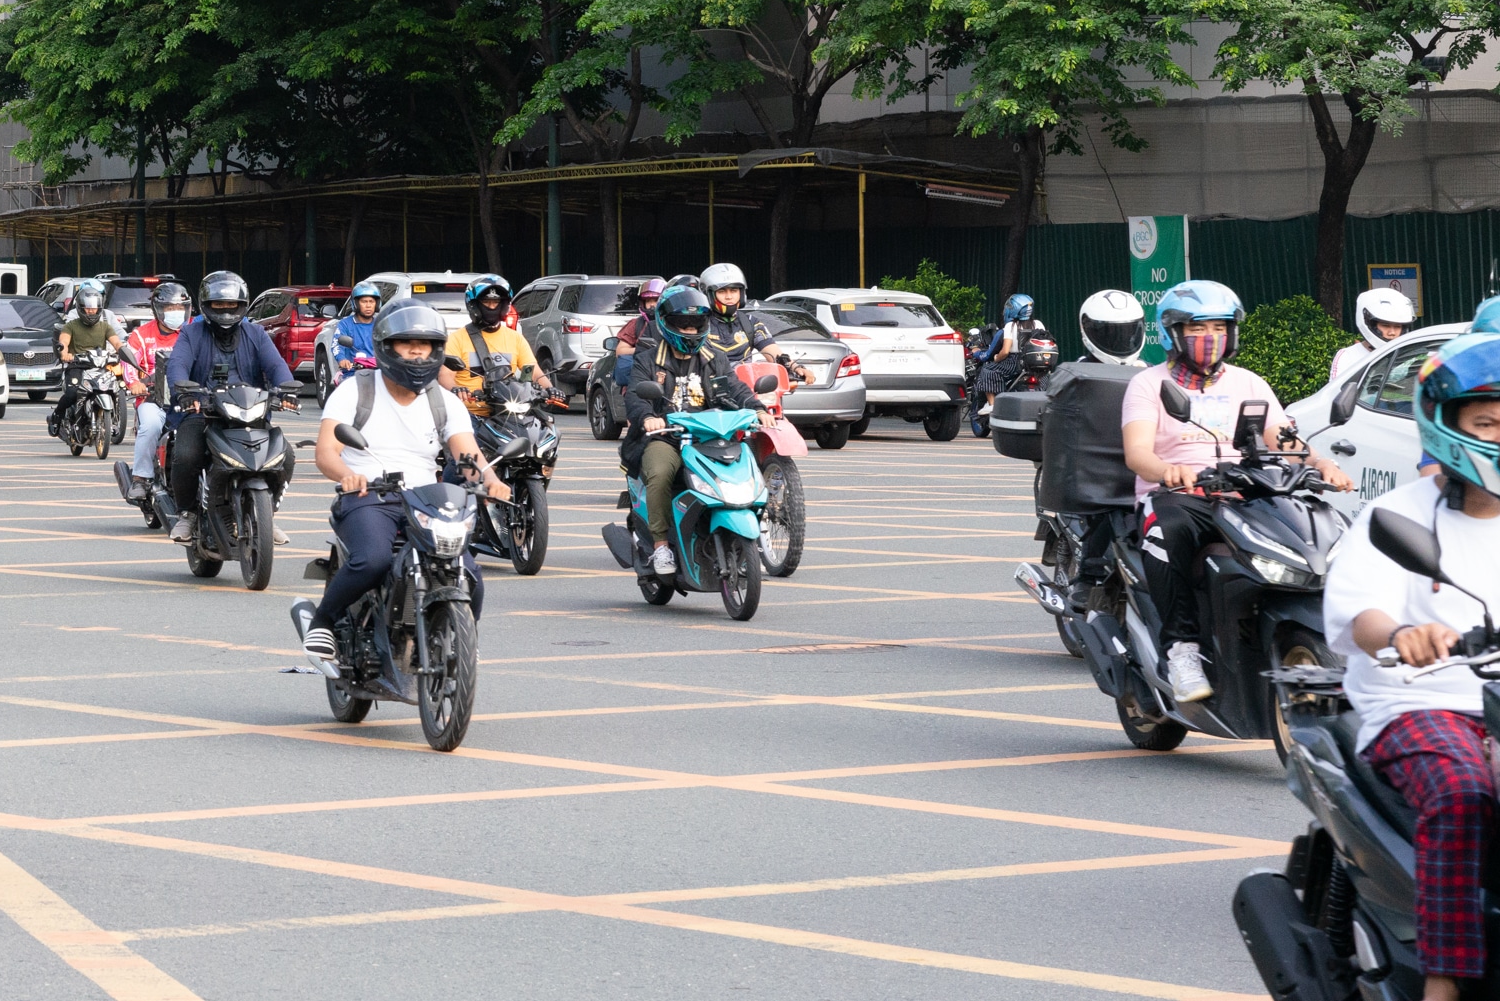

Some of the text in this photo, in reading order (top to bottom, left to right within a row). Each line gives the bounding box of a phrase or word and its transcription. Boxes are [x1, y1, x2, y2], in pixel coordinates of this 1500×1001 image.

[1135, 231, 1149, 241] BGC
[1151, 267, 1167, 283] NO
[1383, 268, 1406, 276] NOTICE
[1360, 466, 1397, 501] AIRCON
